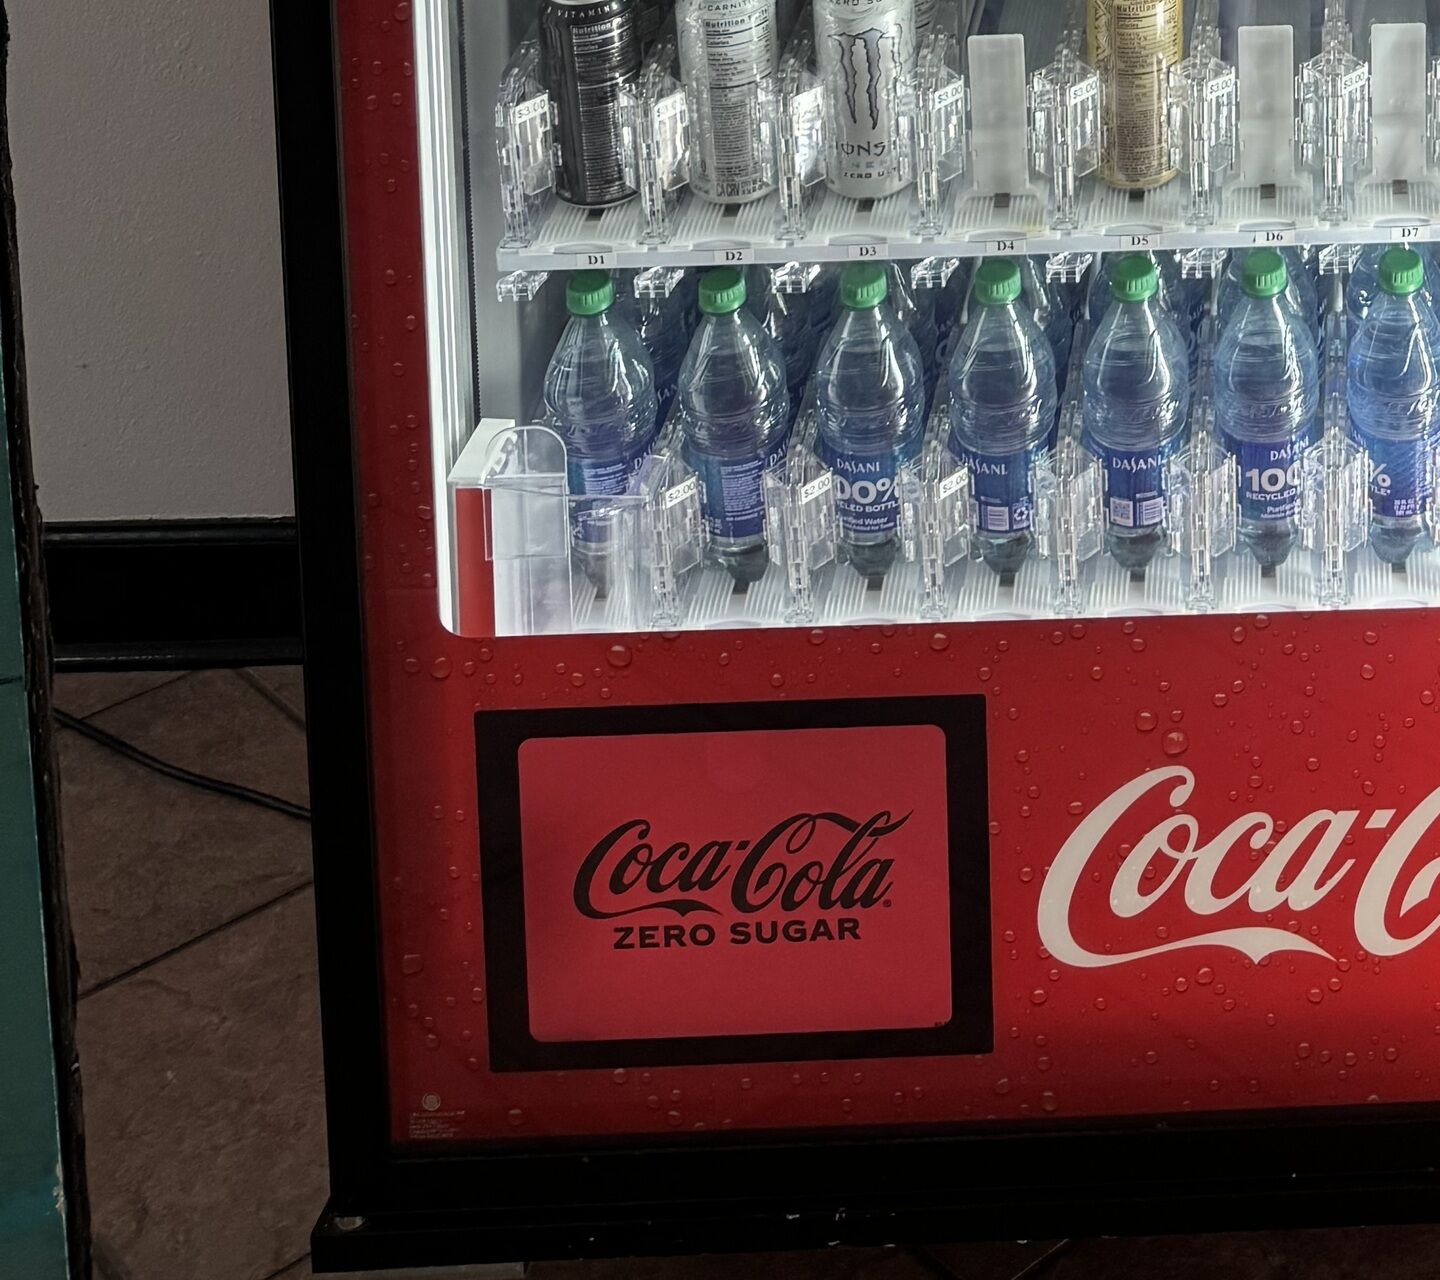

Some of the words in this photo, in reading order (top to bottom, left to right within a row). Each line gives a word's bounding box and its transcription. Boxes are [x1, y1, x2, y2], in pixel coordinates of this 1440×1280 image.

[1209, 77, 1232, 96] $3.00
[1344, 71, 1366, 90] $3.00
[1073, 80, 1097, 99] $3.00
[516, 100, 546, 118] $3.00
[1131, 235, 1149, 246] D5
[1265, 231, 1283, 241] D6
[1402, 227, 1419, 237] D7
[859, 246, 877, 257] D3
[996, 241, 1014, 251] D4
[588, 255, 605, 265] D1
[725, 250, 742, 261] D2
[837, 458, 880, 474] DASANI
[1112, 454, 1162, 470] DASANI
[804, 476, 830, 498] $2.00
[942, 472, 967, 493] $2.00
[667, 481, 696, 502] $2.00
[573, 807, 914, 920] Coca-Cola
[612, 924, 716, 951] ZERO
[729, 917, 861, 945] SUGAR
